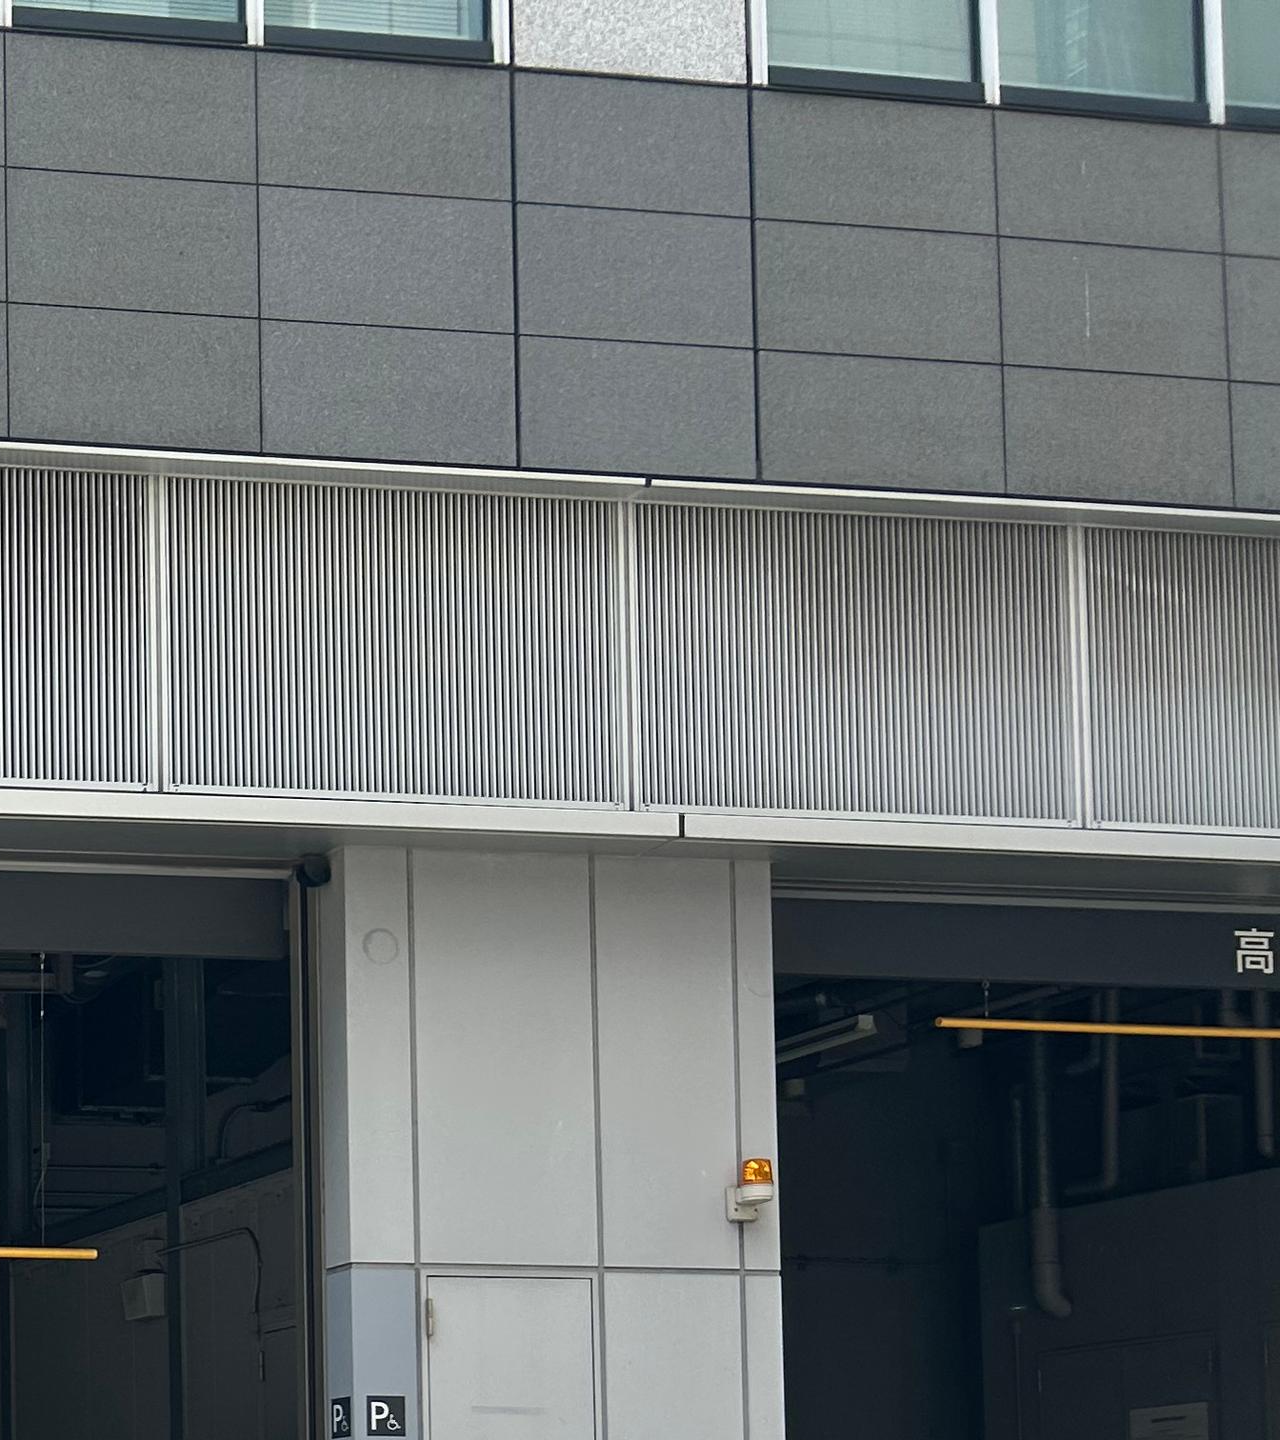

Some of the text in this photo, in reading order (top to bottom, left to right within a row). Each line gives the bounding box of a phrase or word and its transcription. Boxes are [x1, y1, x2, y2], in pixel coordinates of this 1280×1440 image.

[1234, 928, 1274, 973] 高
[333, 1404, 343, 1433] P
[371, 1401, 389, 1430] P
